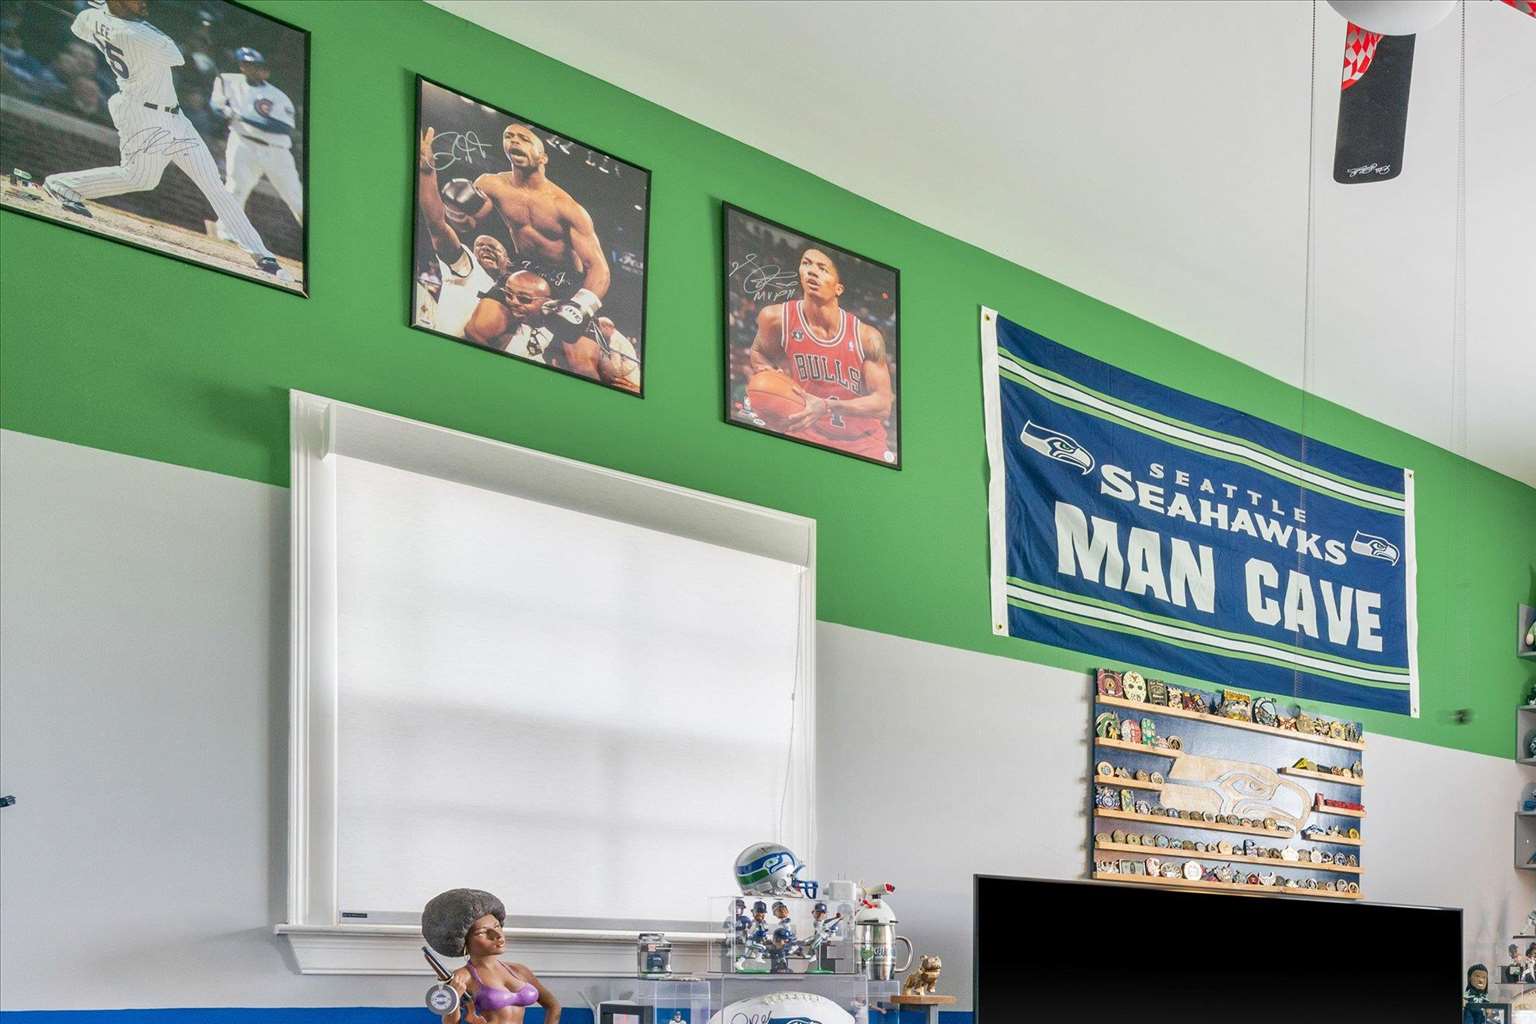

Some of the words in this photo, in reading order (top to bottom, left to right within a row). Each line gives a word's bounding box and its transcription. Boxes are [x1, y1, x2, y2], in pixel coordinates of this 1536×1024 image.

[92, 32, 129, 79] 5
[95, 20, 111, 41] LEE
[793, 353, 862, 396] BULLS
[1100, 464, 1348, 566] SEAHAWKS
[1149, 463, 1307, 523] SEATTLE
[1054, 500, 1216, 614] MAN
[1245, 557, 1383, 653] CAVE
